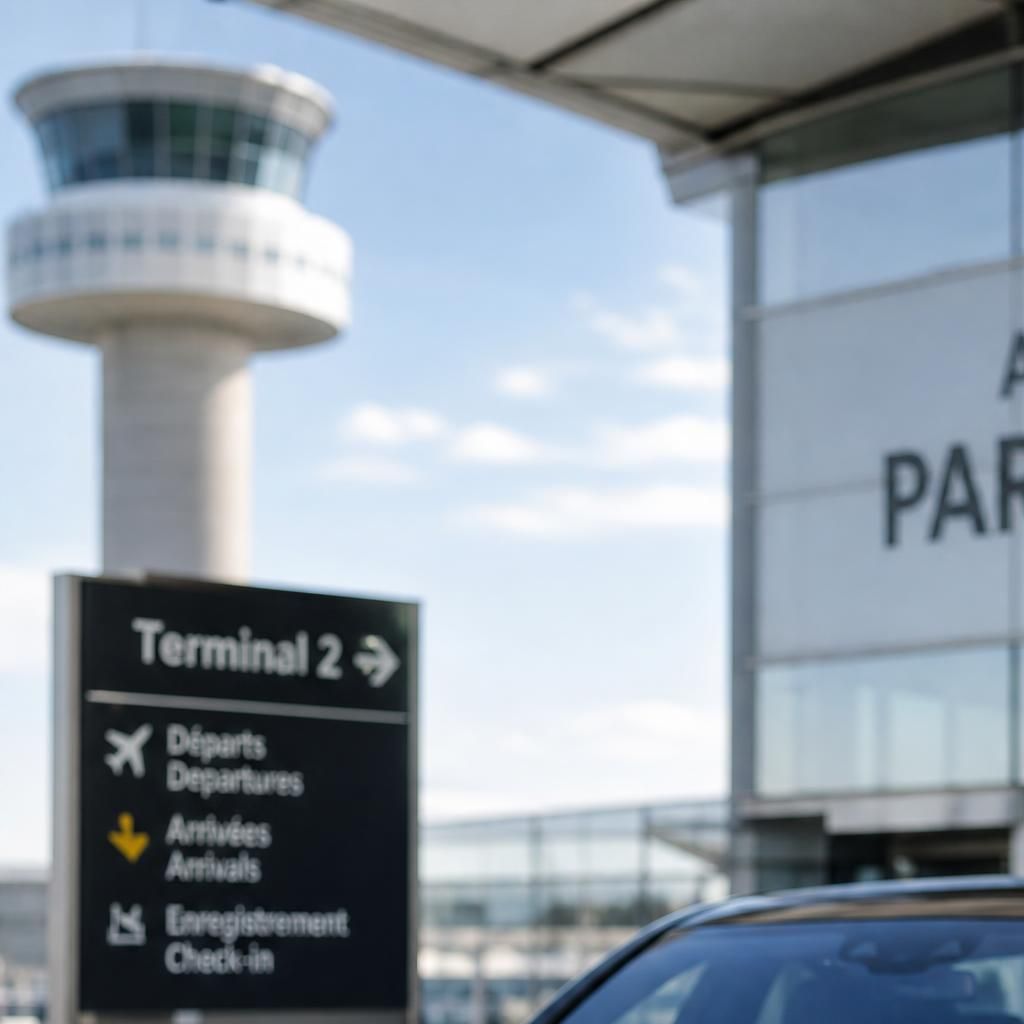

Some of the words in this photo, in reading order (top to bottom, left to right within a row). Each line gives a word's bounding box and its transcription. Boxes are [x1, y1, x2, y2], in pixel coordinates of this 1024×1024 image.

[132, 617, 308, 677] Terminal
[316, 633, 344, 680] 2
[166, 724, 267, 761] Départs
[166, 764, 304, 799] Departures
[165, 813, 271, 847] Arrivées
[165, 851, 261, 884] Arrivals
[165, 903, 349, 942] Enregistrement
[165, 942, 274, 975] Check-in
